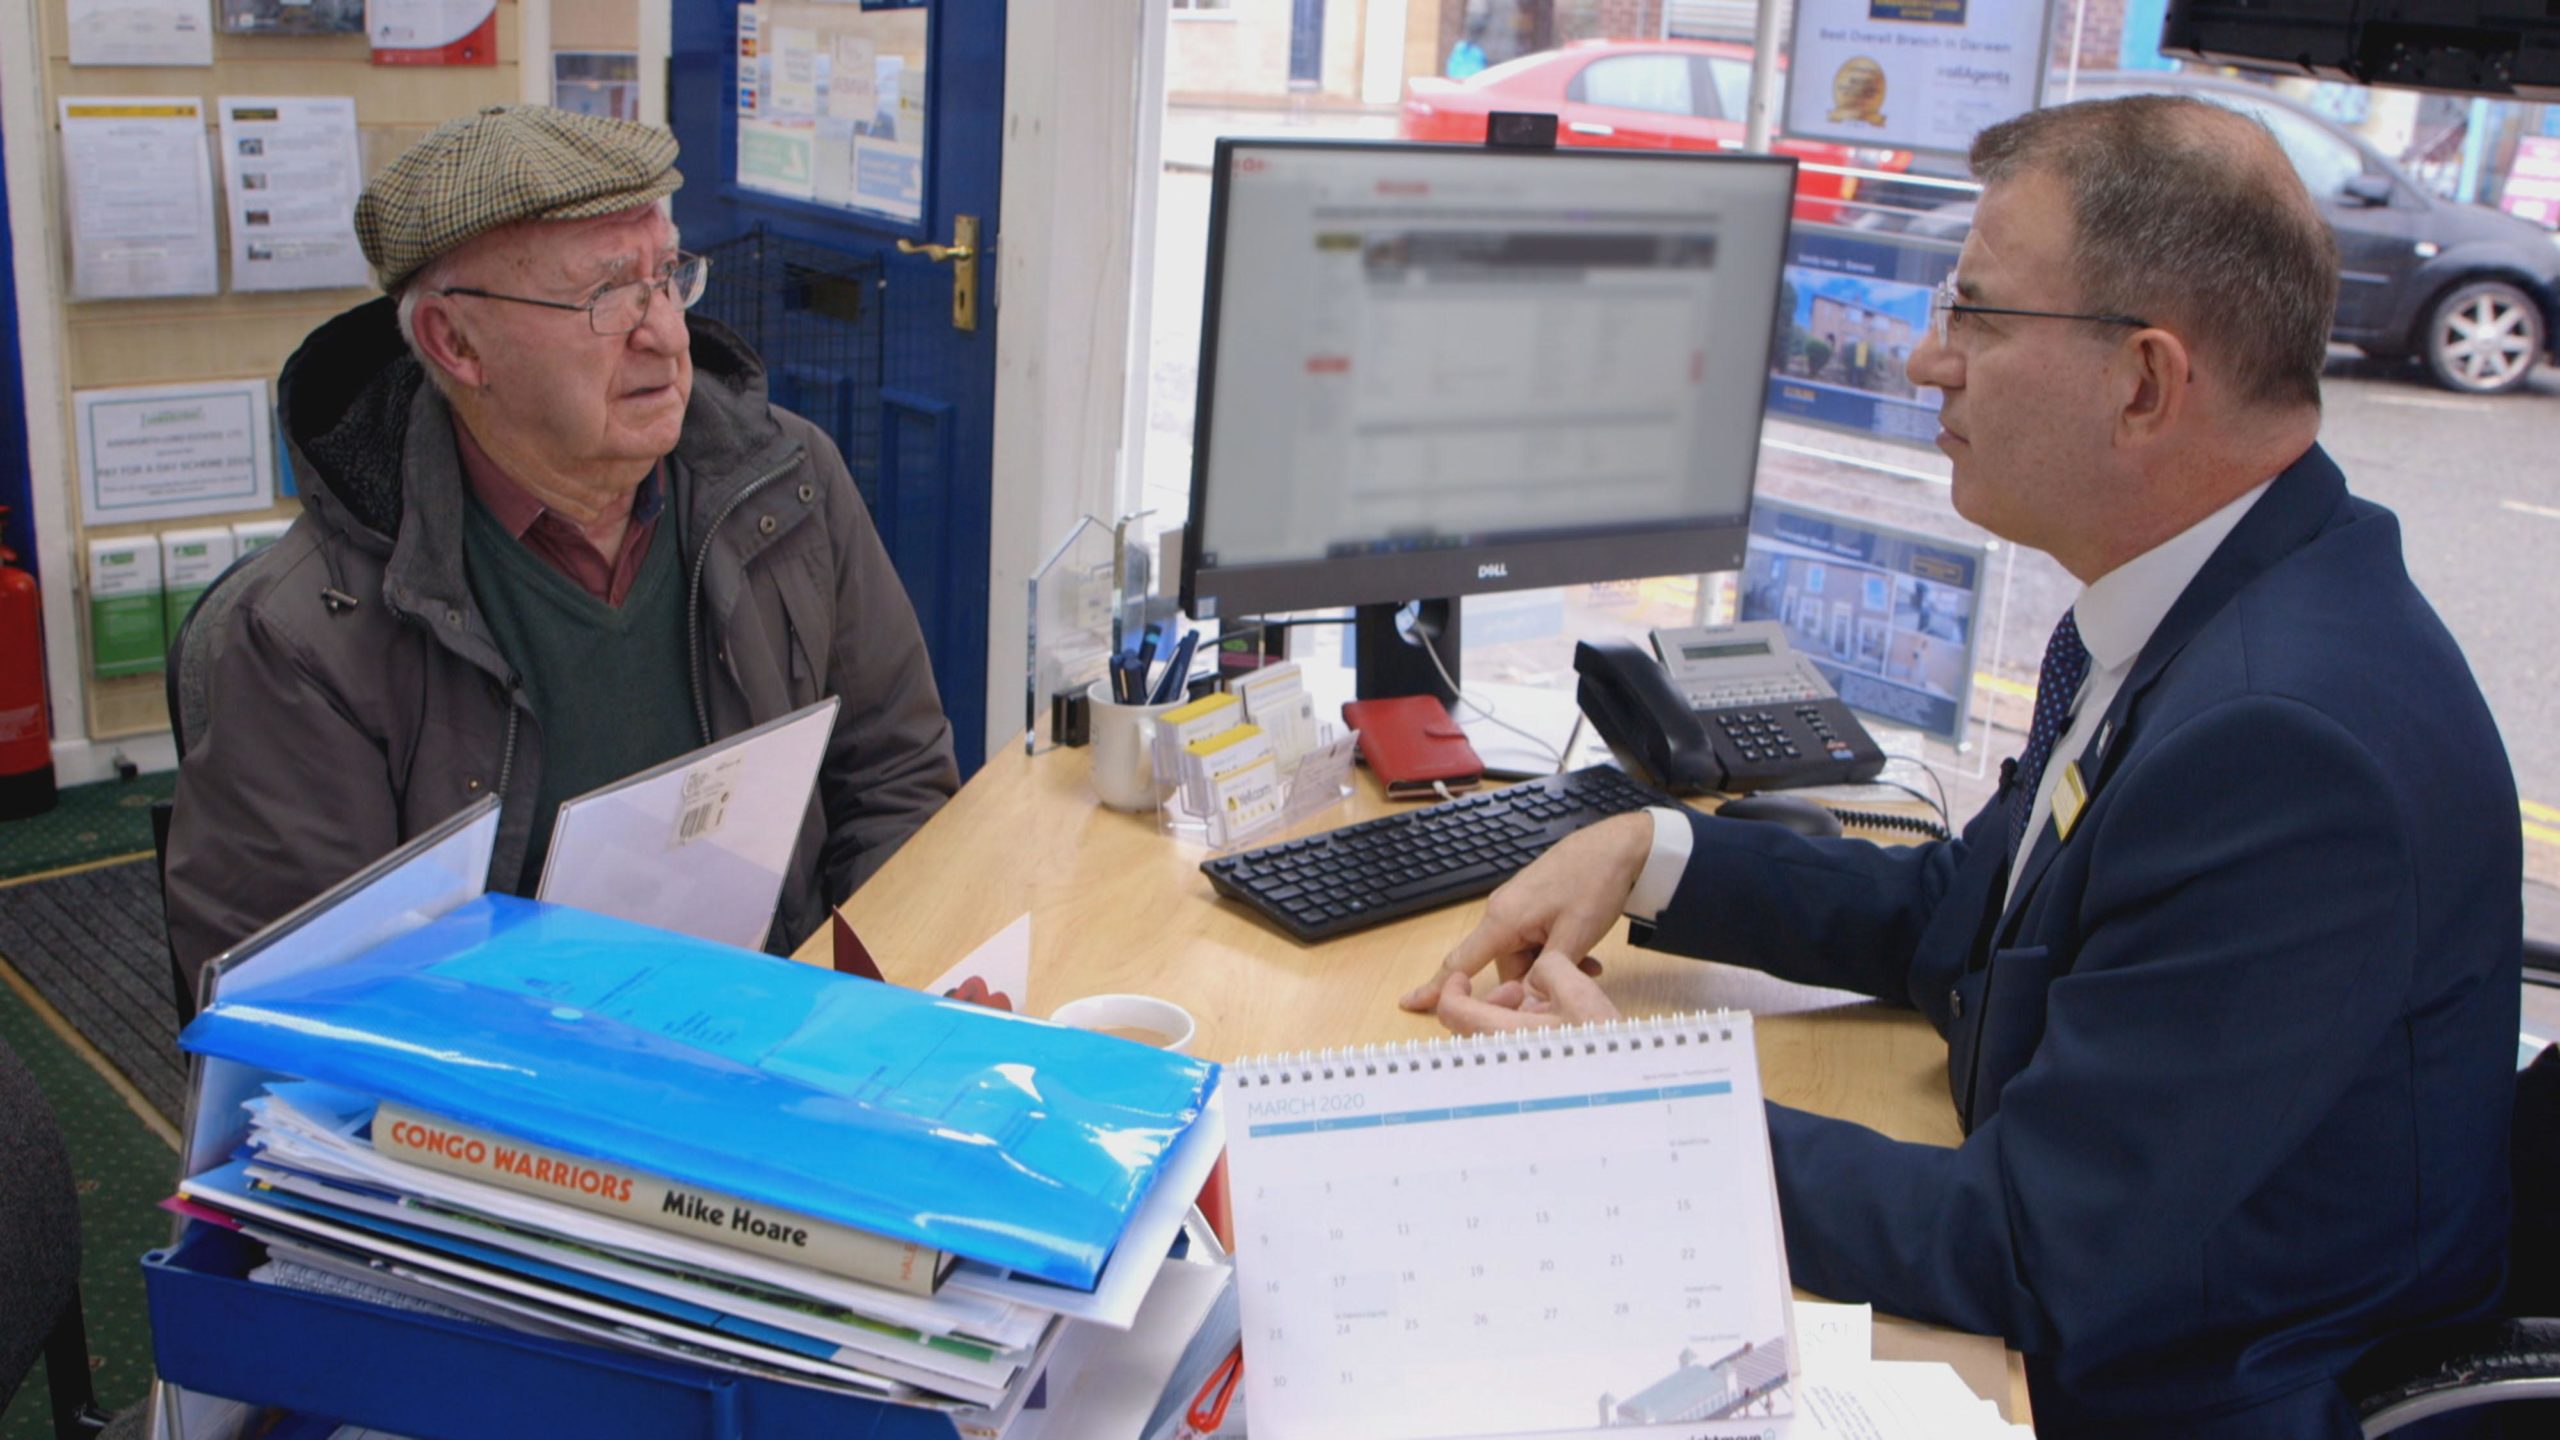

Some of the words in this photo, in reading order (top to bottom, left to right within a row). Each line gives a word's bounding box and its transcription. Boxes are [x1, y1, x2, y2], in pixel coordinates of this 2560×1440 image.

[1478, 562, 1508, 578] DELL
[1249, 1097, 1316, 1117] MARCH
[1320, 1093, 1365, 1112] 2020
[391, 1120, 487, 1165] CONGO
[492, 1146, 635, 1202] WARRIORS
[661, 1189, 725, 1228] Mike
[730, 1206, 808, 1248] Hoare
